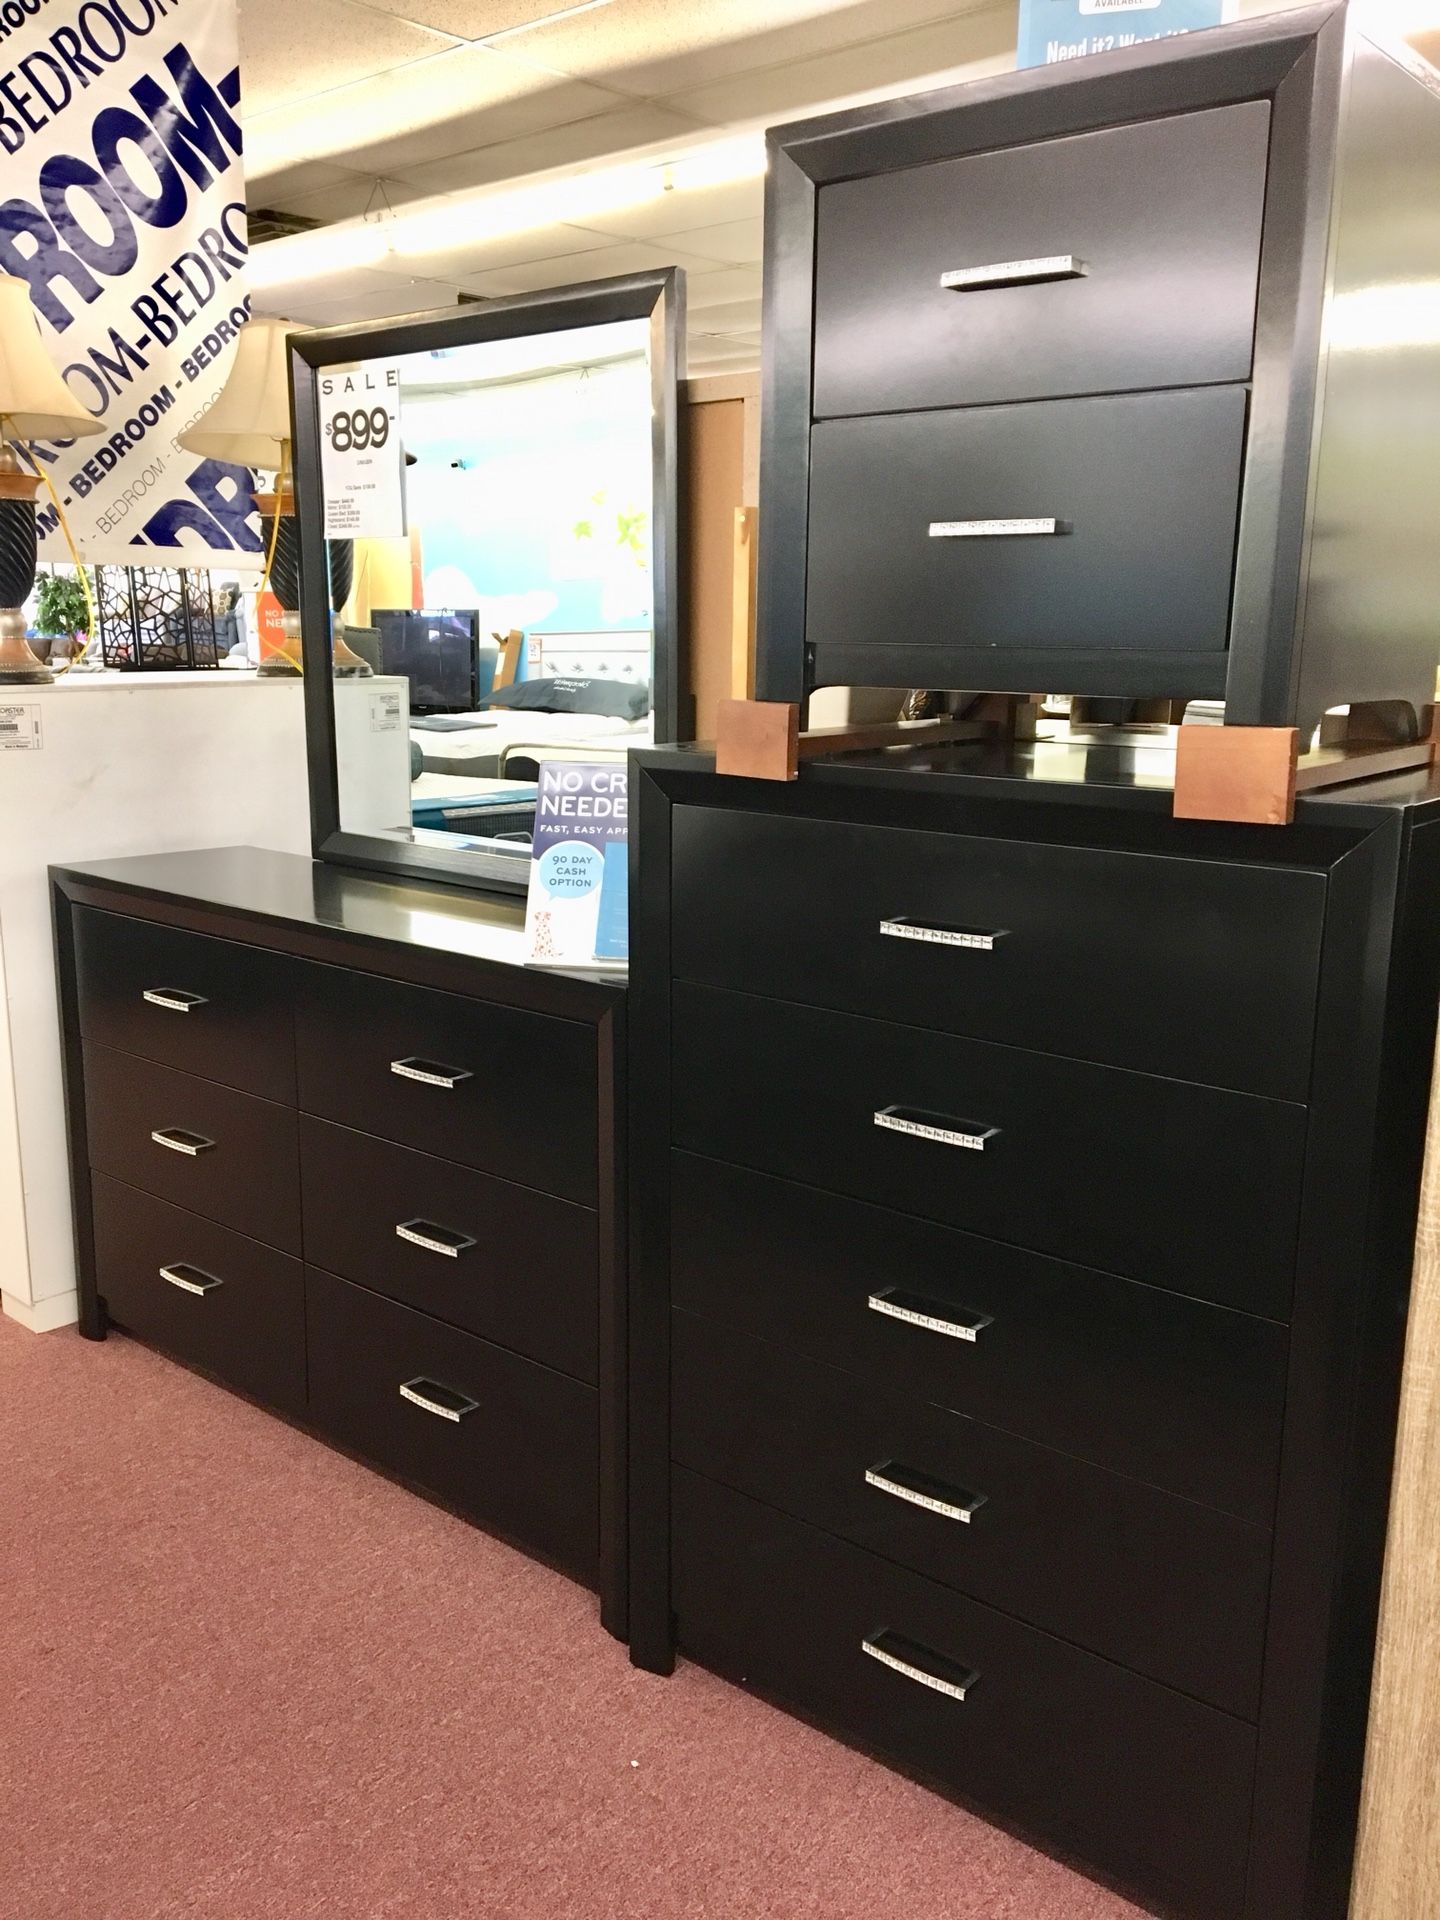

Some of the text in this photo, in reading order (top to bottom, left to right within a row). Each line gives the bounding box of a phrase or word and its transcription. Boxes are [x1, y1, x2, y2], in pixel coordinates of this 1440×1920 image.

[1047, 38, 1087, 64] Need
[322, 370, 397, 395] SALE
[69, 384, 176, 499] BEDROOM
[95, 456, 166, 535] BEDROOM
[543, 770, 583, 793] NO
[540, 824, 570, 834] FAST,
[574, 826, 603, 835] EASY
[552, 855, 593, 865] 90 DAY
[556, 867, 586, 876] CASH
[549, 877, 592, 888] OPTION
